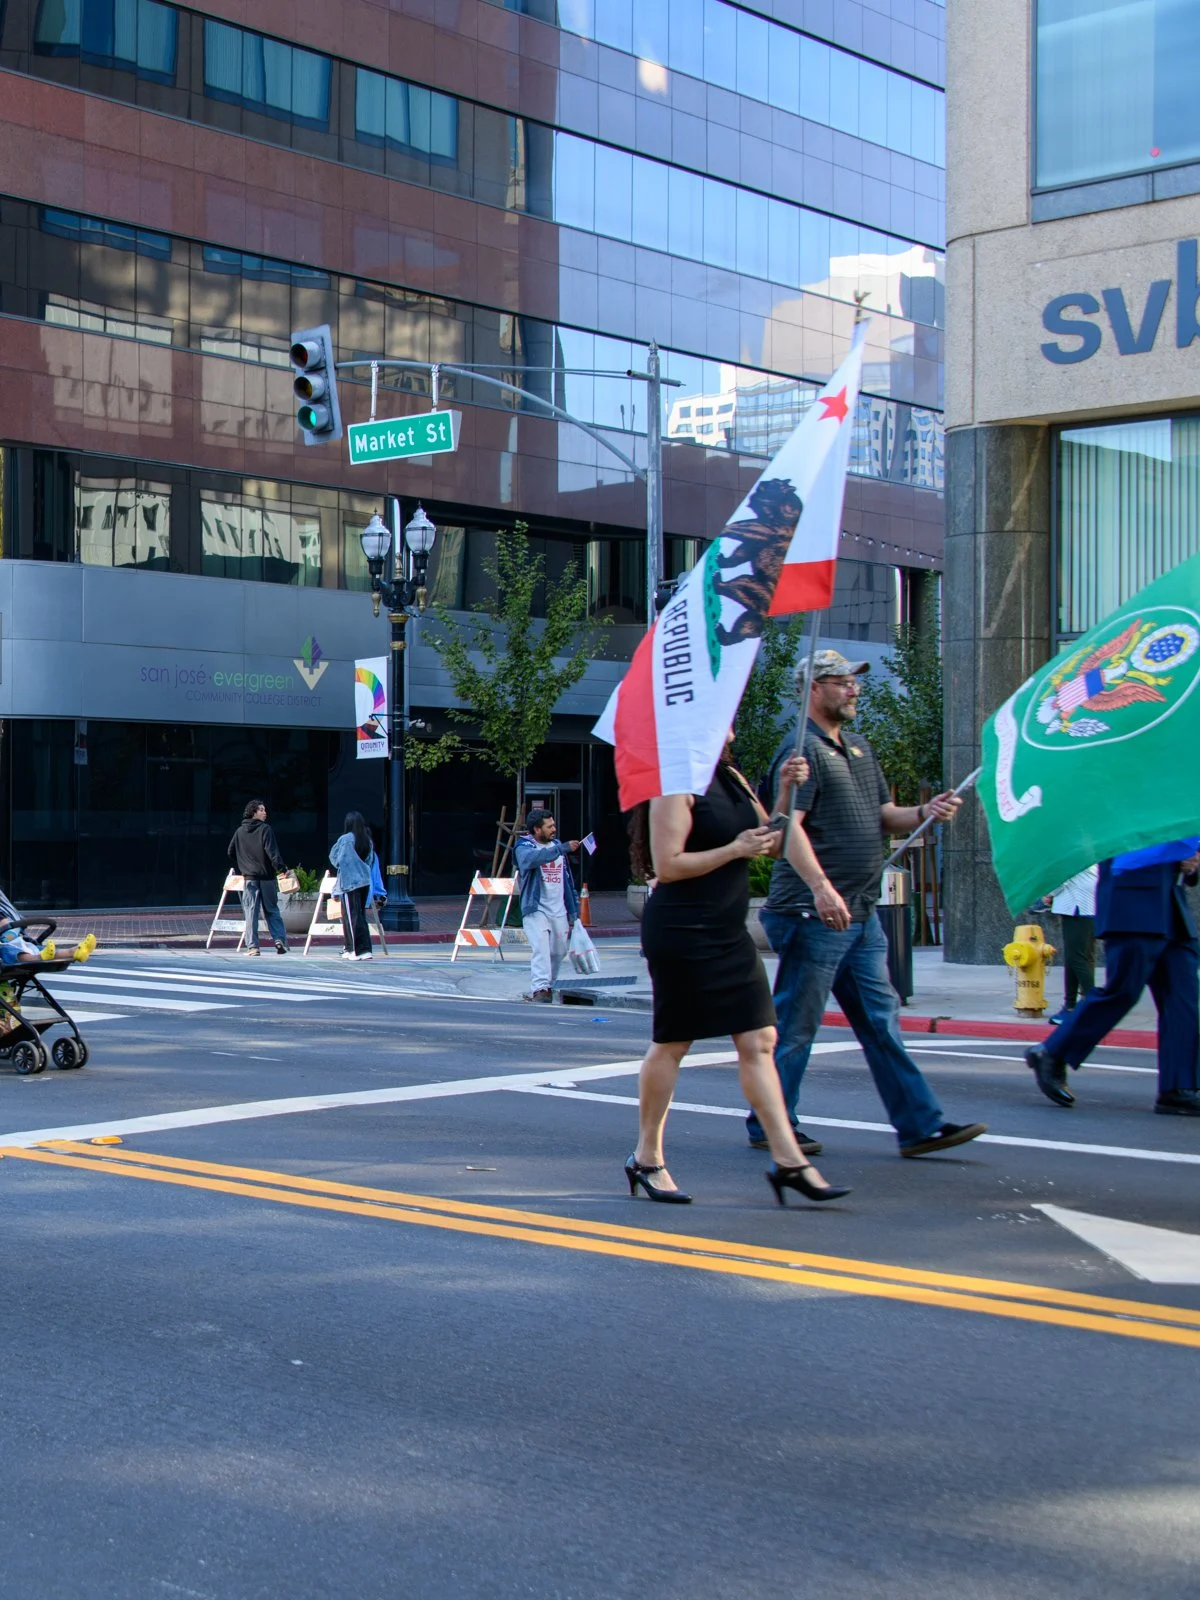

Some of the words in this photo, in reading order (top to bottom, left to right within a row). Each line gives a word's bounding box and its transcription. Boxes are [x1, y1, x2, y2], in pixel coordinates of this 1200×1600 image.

[355, 427, 415, 454] Market
[426, 422, 447, 443] St
[663, 599, 694, 706] REPUBLIC
[140, 666, 170, 683] san
[213, 671, 294, 692] evergreen
[186, 690, 242, 703] COMMUNITY
[245, 693, 285, 706] COLLEGE
[287, 695, 322, 707] DISTRICT
